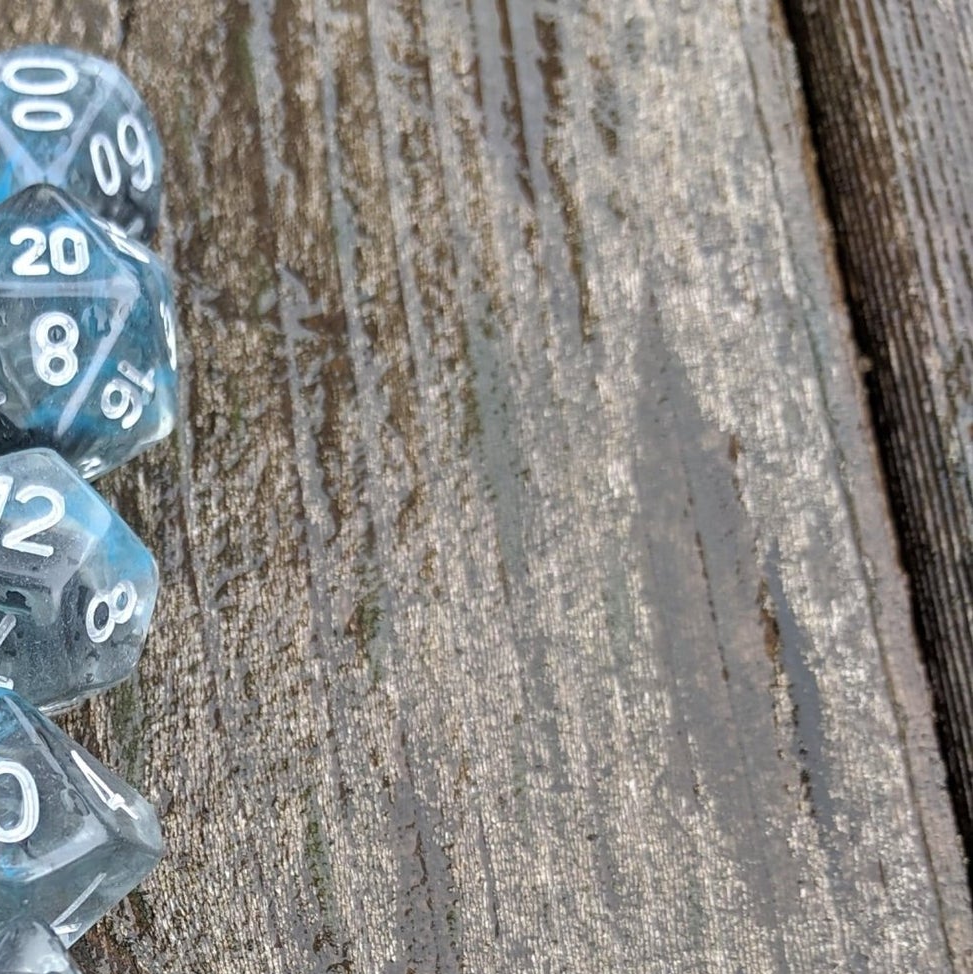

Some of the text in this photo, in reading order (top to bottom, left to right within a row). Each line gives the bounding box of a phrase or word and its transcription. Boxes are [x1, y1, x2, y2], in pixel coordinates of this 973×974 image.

[10, 227, 90, 275] 20
[30, 312, 79, 387] 8
[85, 580, 137, 643] 8
